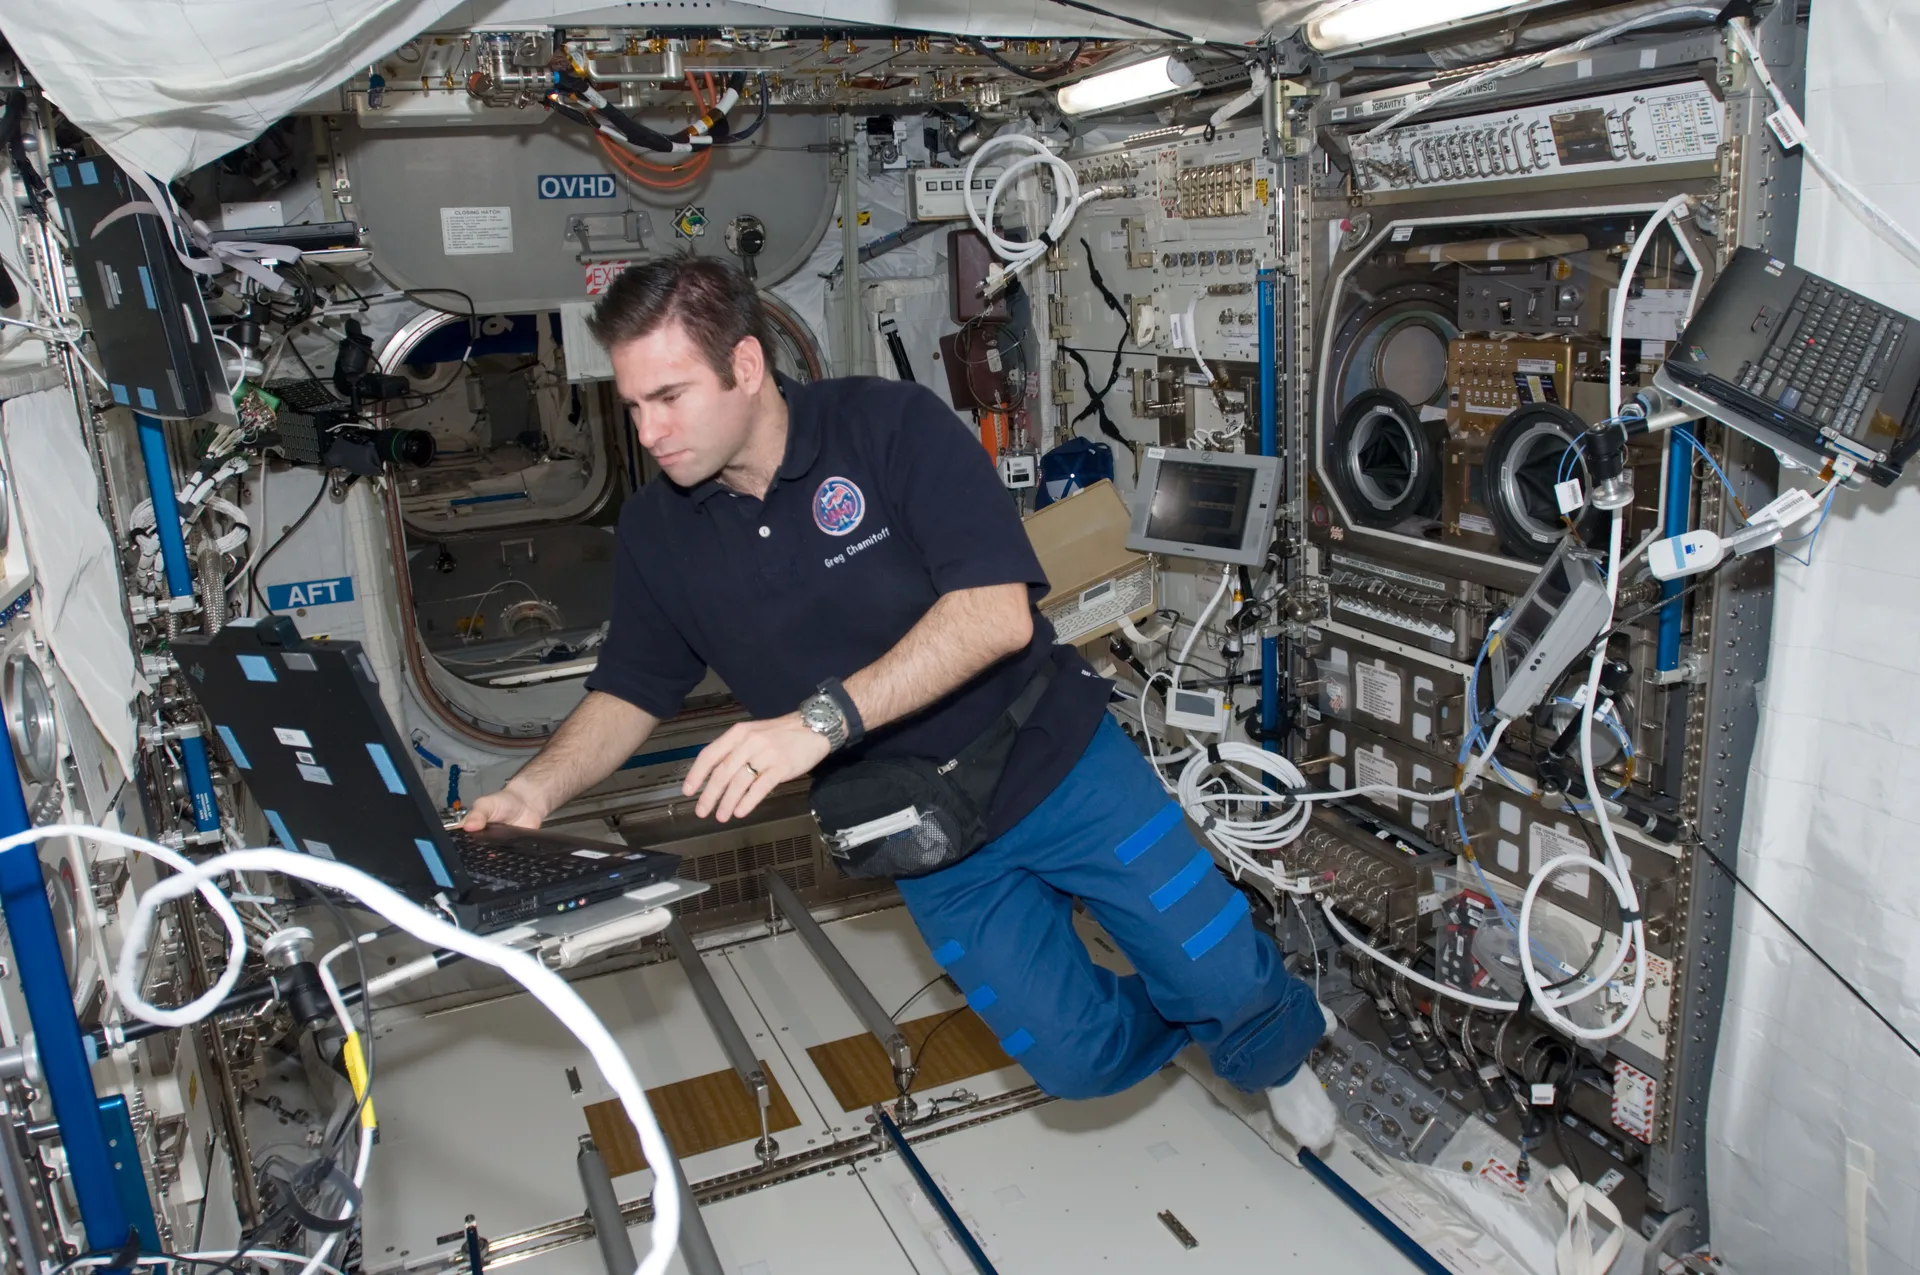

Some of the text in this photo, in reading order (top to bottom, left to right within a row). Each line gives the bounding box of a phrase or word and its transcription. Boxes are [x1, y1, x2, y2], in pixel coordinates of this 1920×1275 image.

[540, 176, 615, 198] OVHD
[824, 526, 890, 568] Greg Chamitoff
[288, 580, 340, 607] AFT
